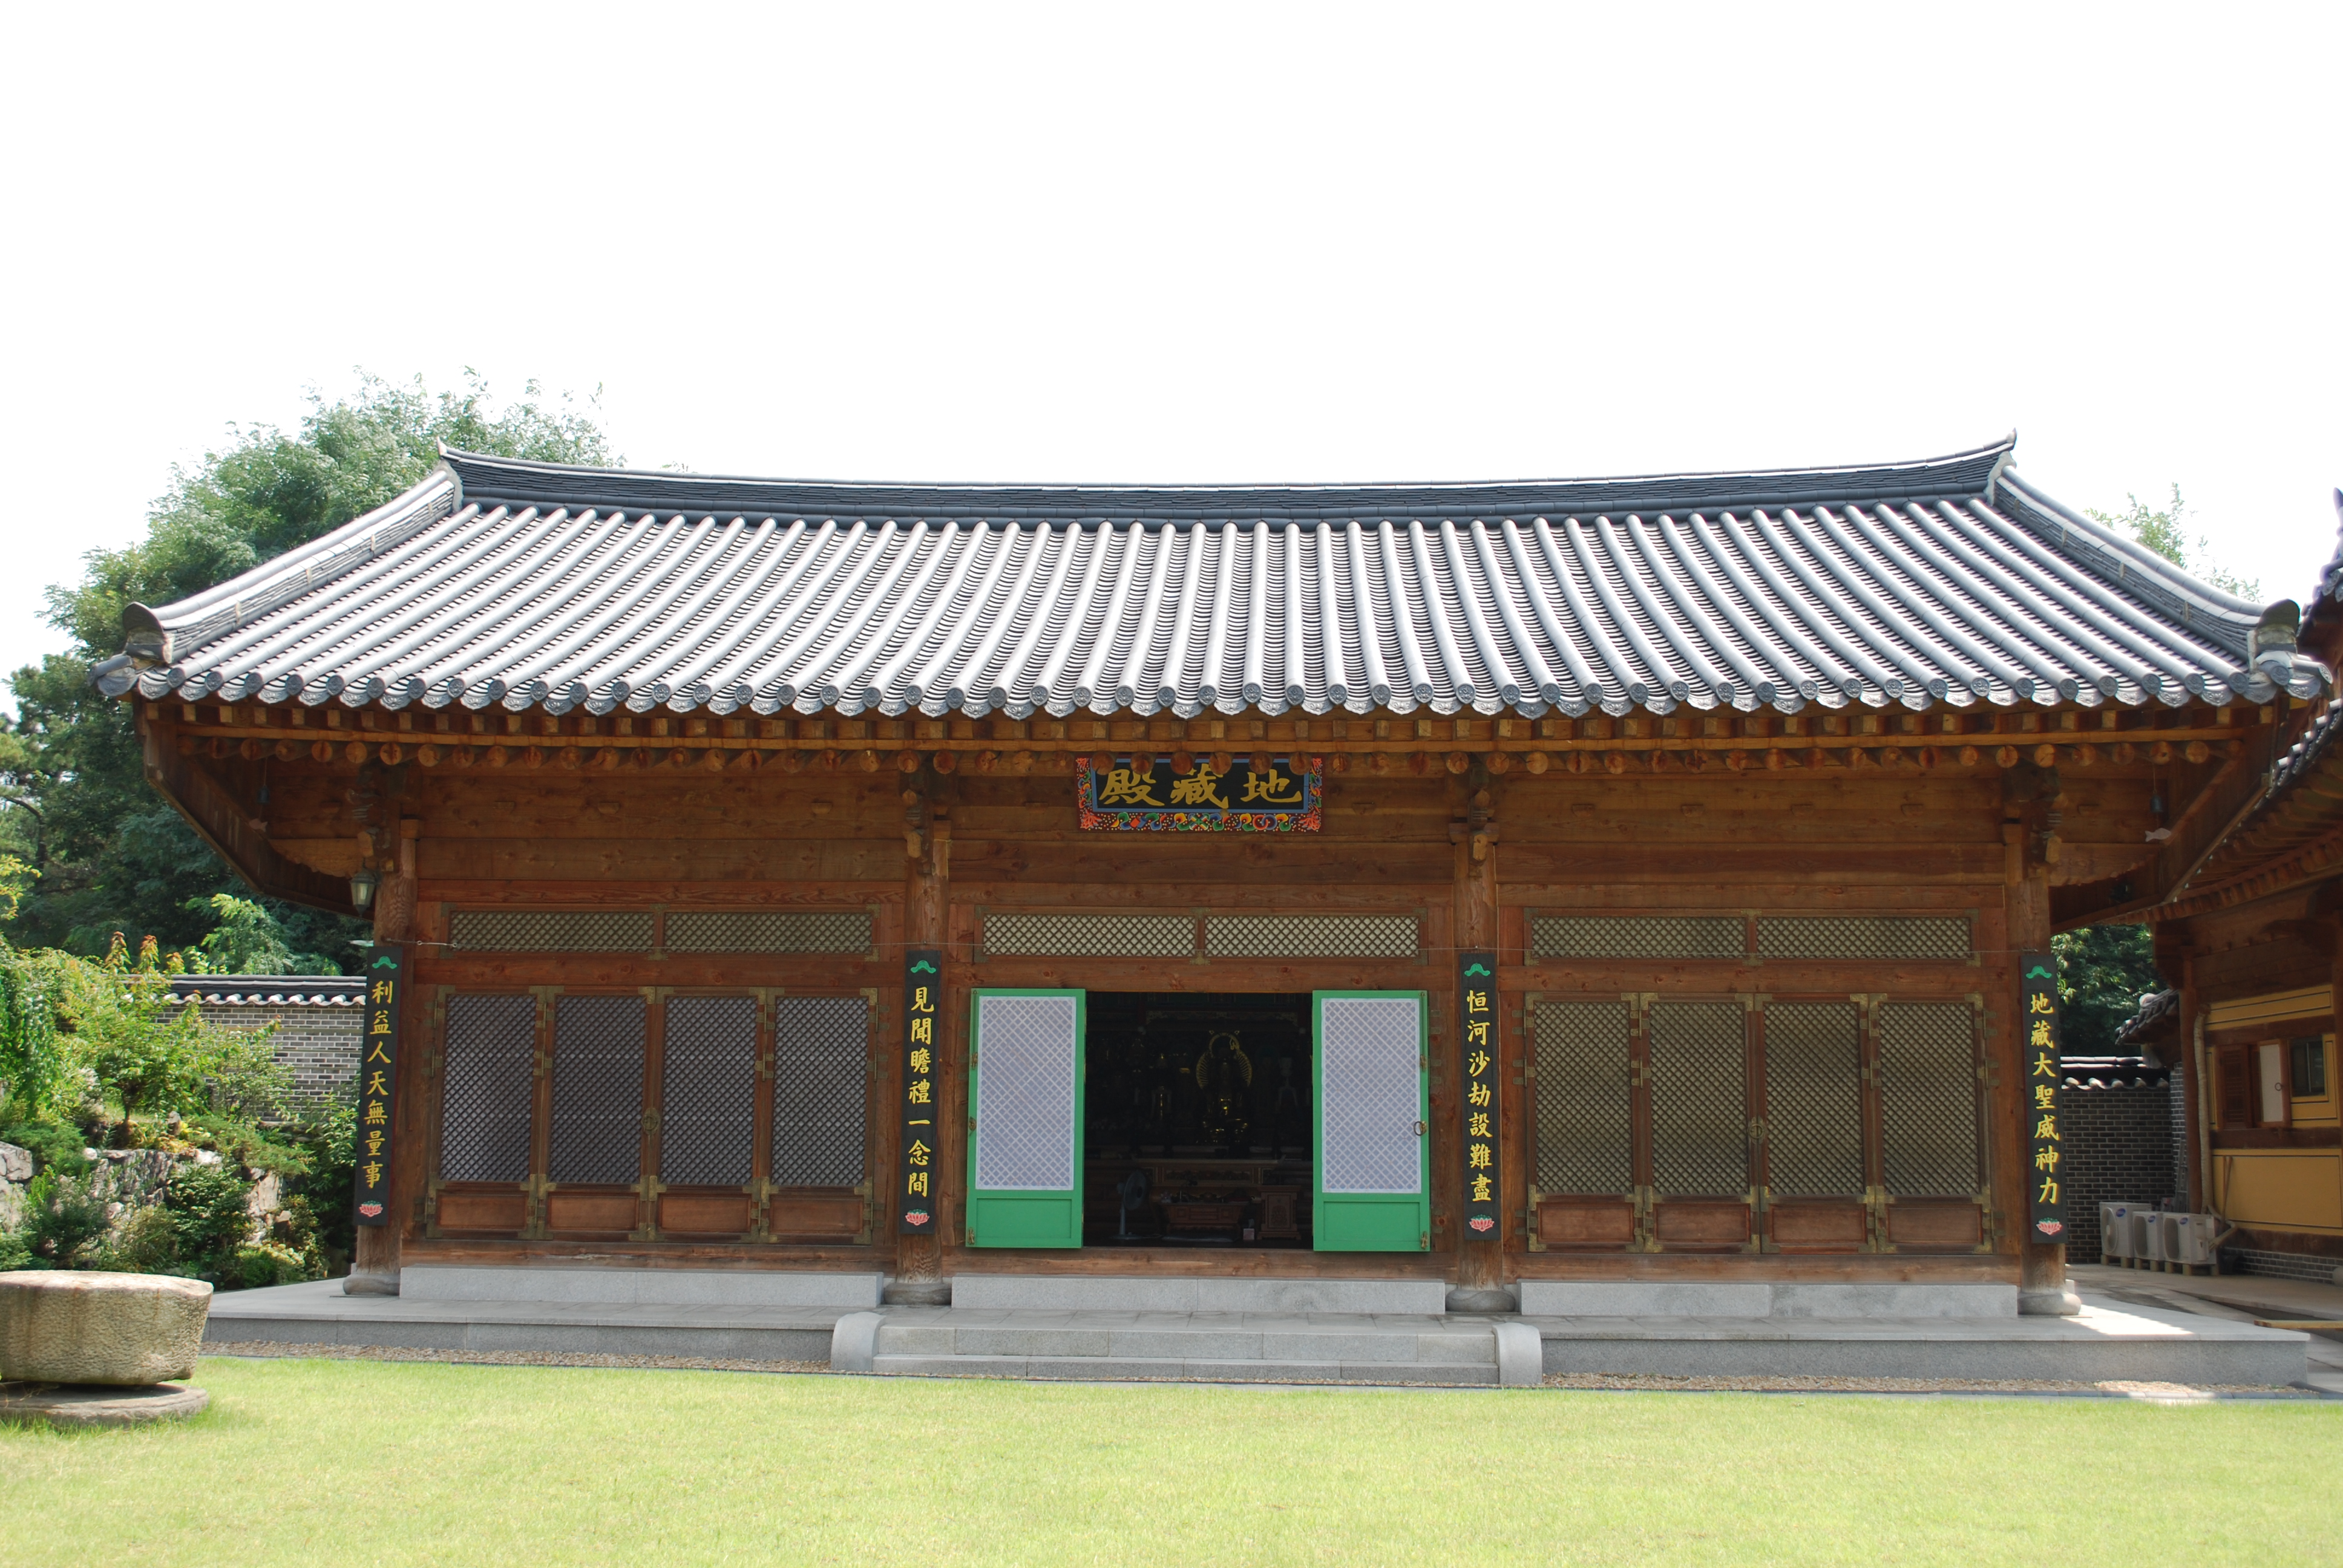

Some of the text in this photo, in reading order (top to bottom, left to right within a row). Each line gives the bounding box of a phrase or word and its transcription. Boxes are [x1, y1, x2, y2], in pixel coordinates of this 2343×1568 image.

[363, 981, 393, 1189] 利益人天無量事
[908, 987, 934, 1198] 見聞瞻禮一念間
[2030, 993, 2060, 1204] 地藏大聖威神力
